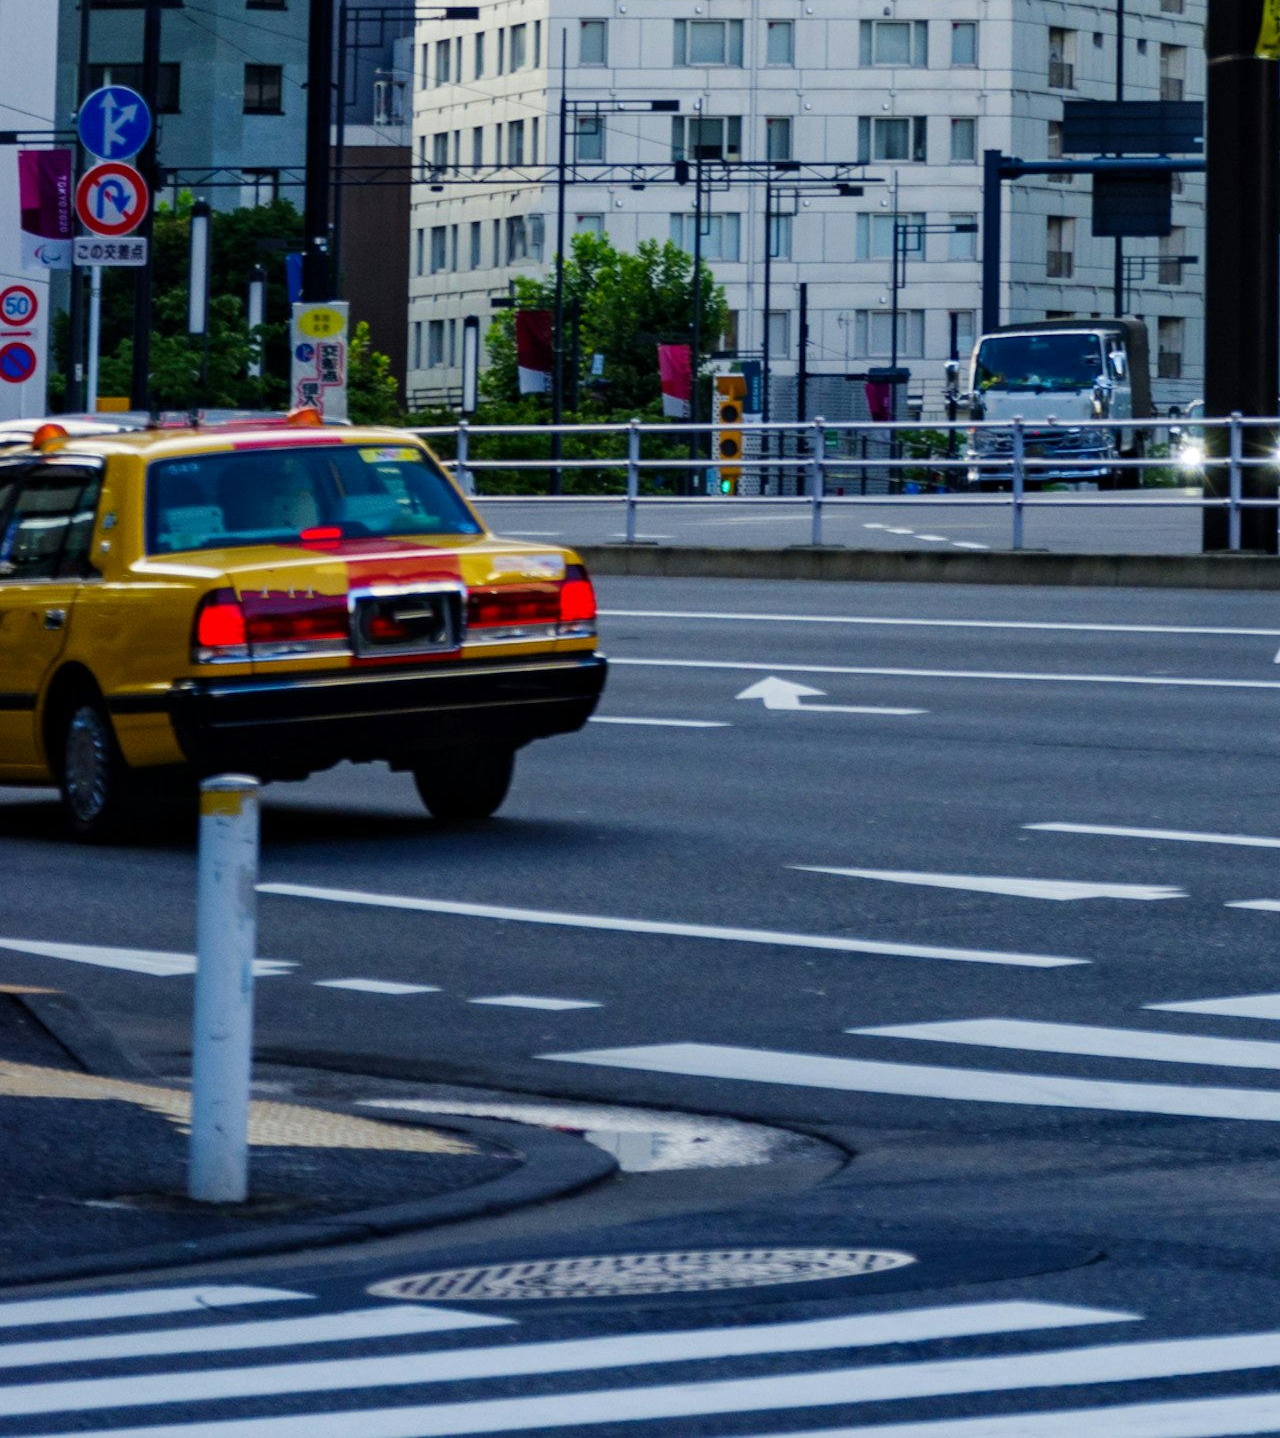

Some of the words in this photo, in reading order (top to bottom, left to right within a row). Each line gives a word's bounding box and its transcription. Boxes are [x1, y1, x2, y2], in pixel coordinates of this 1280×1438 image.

[57, 175, 68, 208] TOKYO
[77, 244, 144, 261] この交差点
[5, 296, 29, 315] 50
